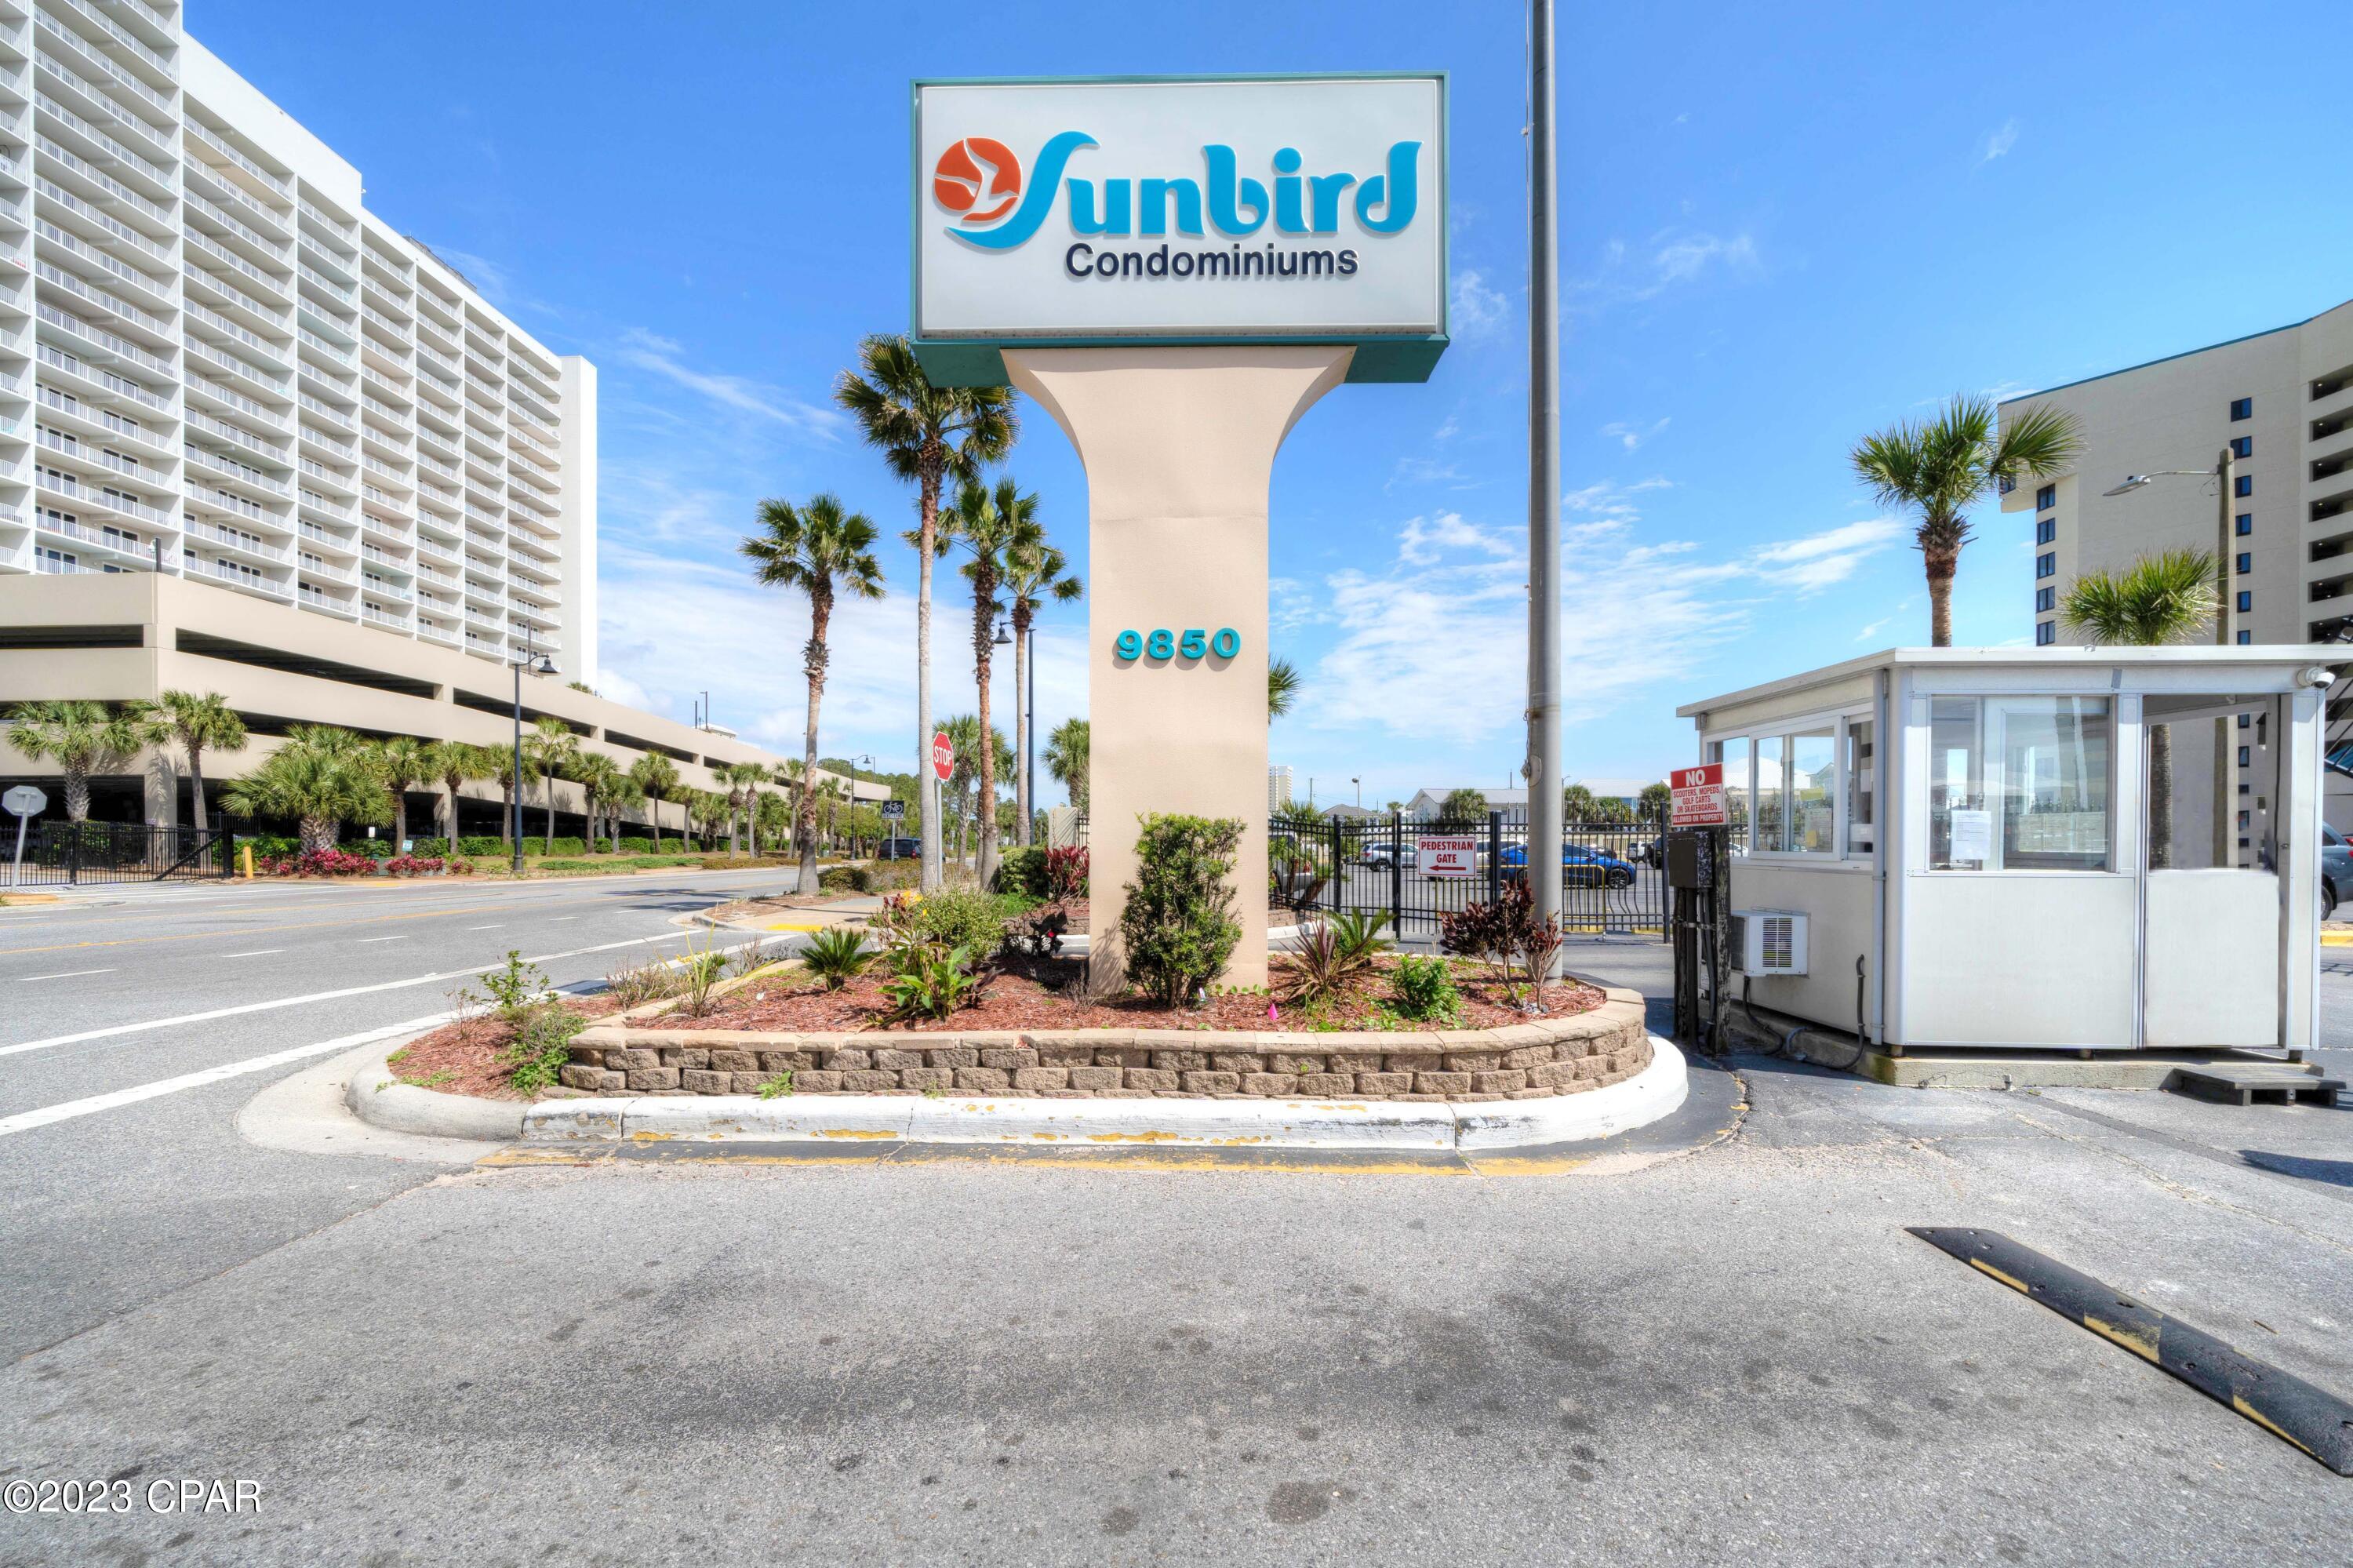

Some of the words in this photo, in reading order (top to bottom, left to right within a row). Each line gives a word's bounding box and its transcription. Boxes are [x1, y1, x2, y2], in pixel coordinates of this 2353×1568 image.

[944, 130, 1424, 249] Sunbird
[1066, 242, 1359, 277] Condominiums
[1117, 627, 1242, 661] 9850
[933, 745, 952, 767] STOP
[1686, 769, 1706, 788] NO
[1673, 789, 1698, 798] SCOOTERS,
[1699, 786, 1721, 795] MOPEDS,
[1695, 795, 1711, 804] CARTS
[1684, 803, 1718, 813] SKATEBOARDS
[1700, 813, 1723, 822] PROPERTY
[1420, 841, 1474, 851] PEDESTRIAN
[1436, 853, 1457, 864] GATE
